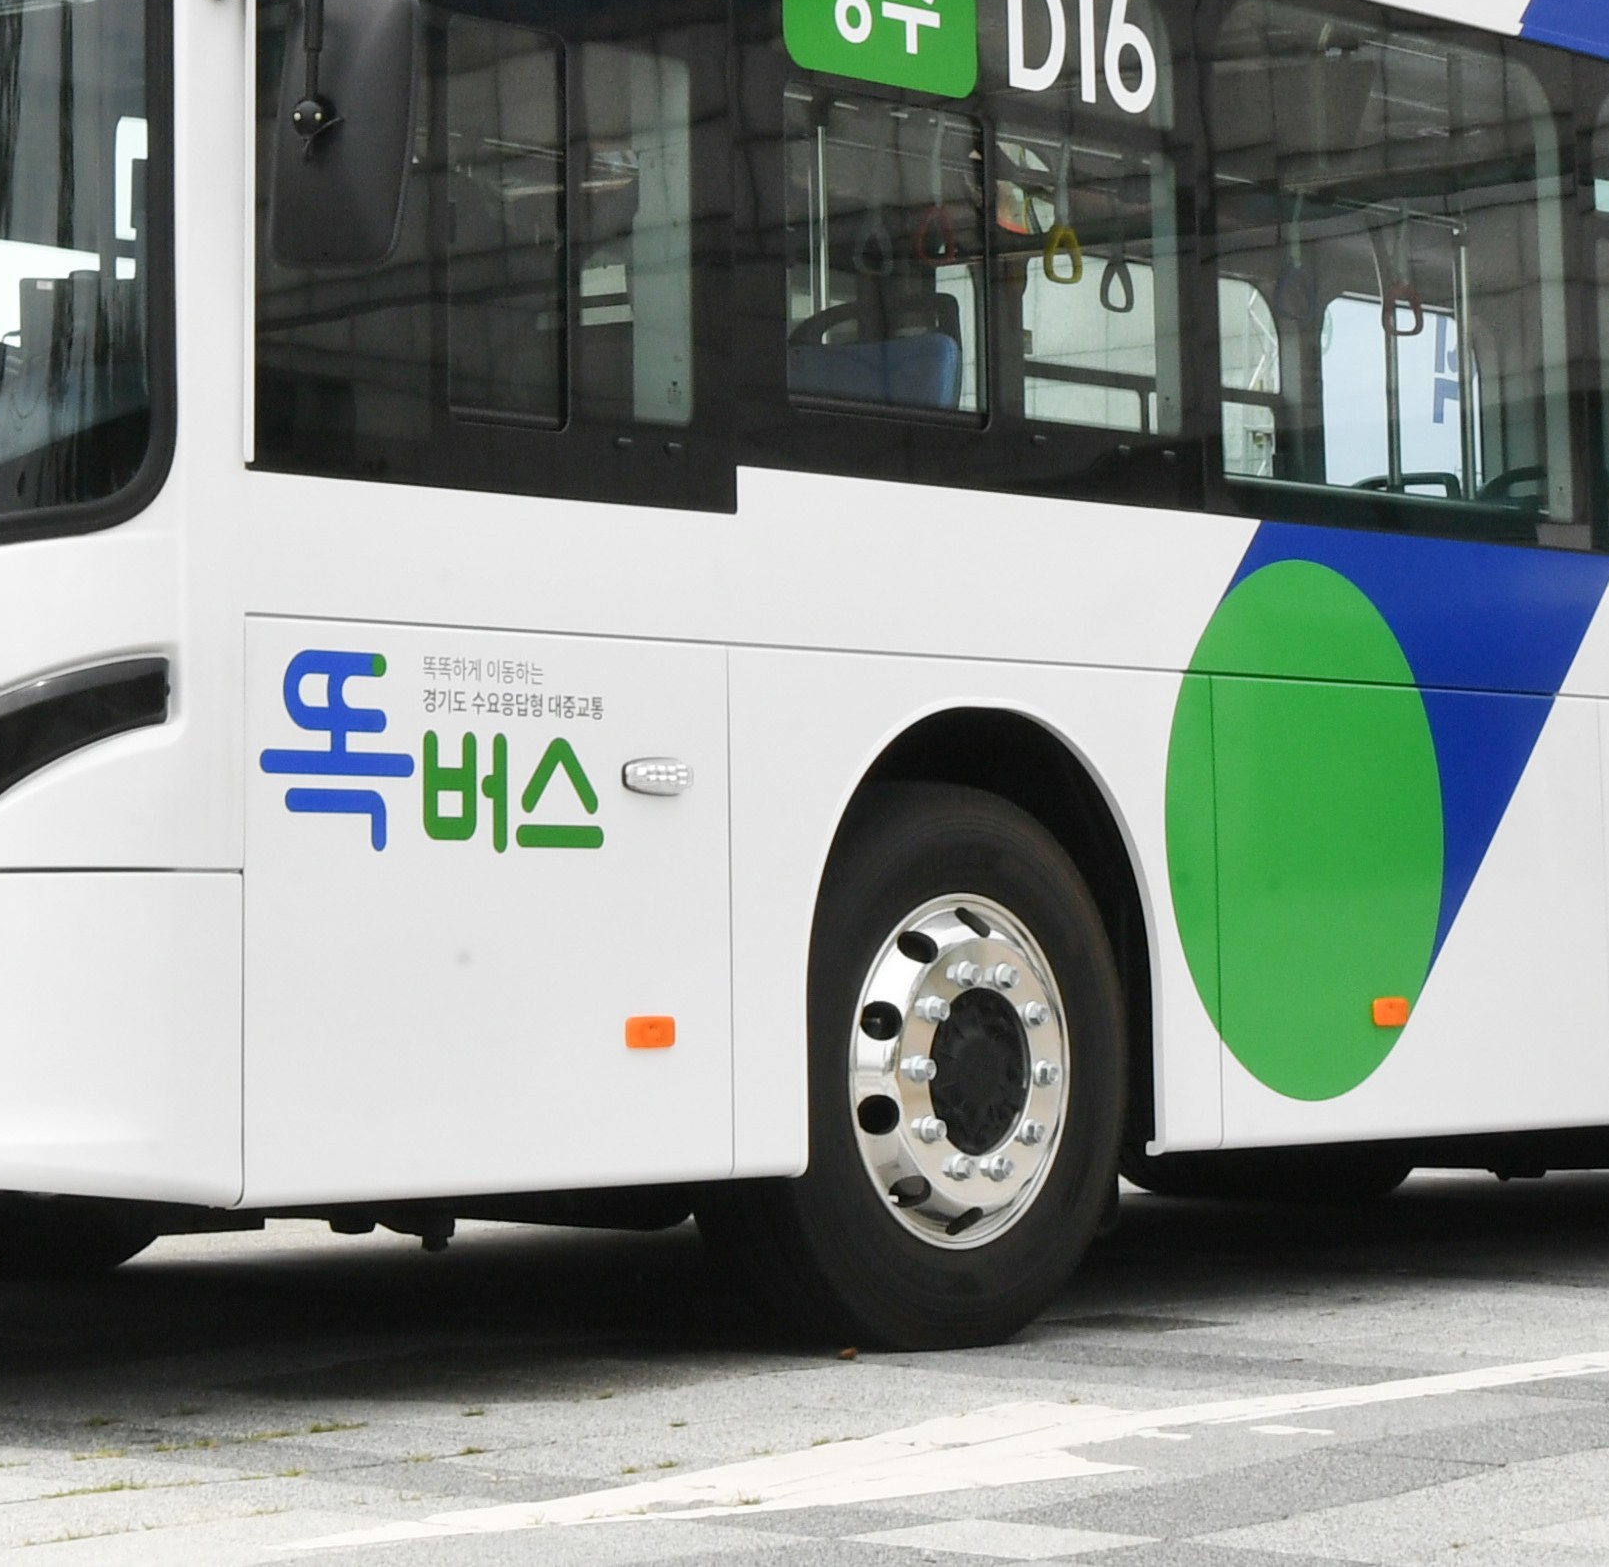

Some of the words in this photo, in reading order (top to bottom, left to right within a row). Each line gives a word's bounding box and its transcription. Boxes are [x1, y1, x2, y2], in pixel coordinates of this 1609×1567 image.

[423, 655, 482, 683] 똑똑하게
[486, 659, 544, 686] 이동하는
[422, 688, 468, 714] 경기도
[471, 690, 543, 718] 수요응답형
[548, 694, 604, 721] 대중교통
[259, 649, 604, 853] 똑버스
